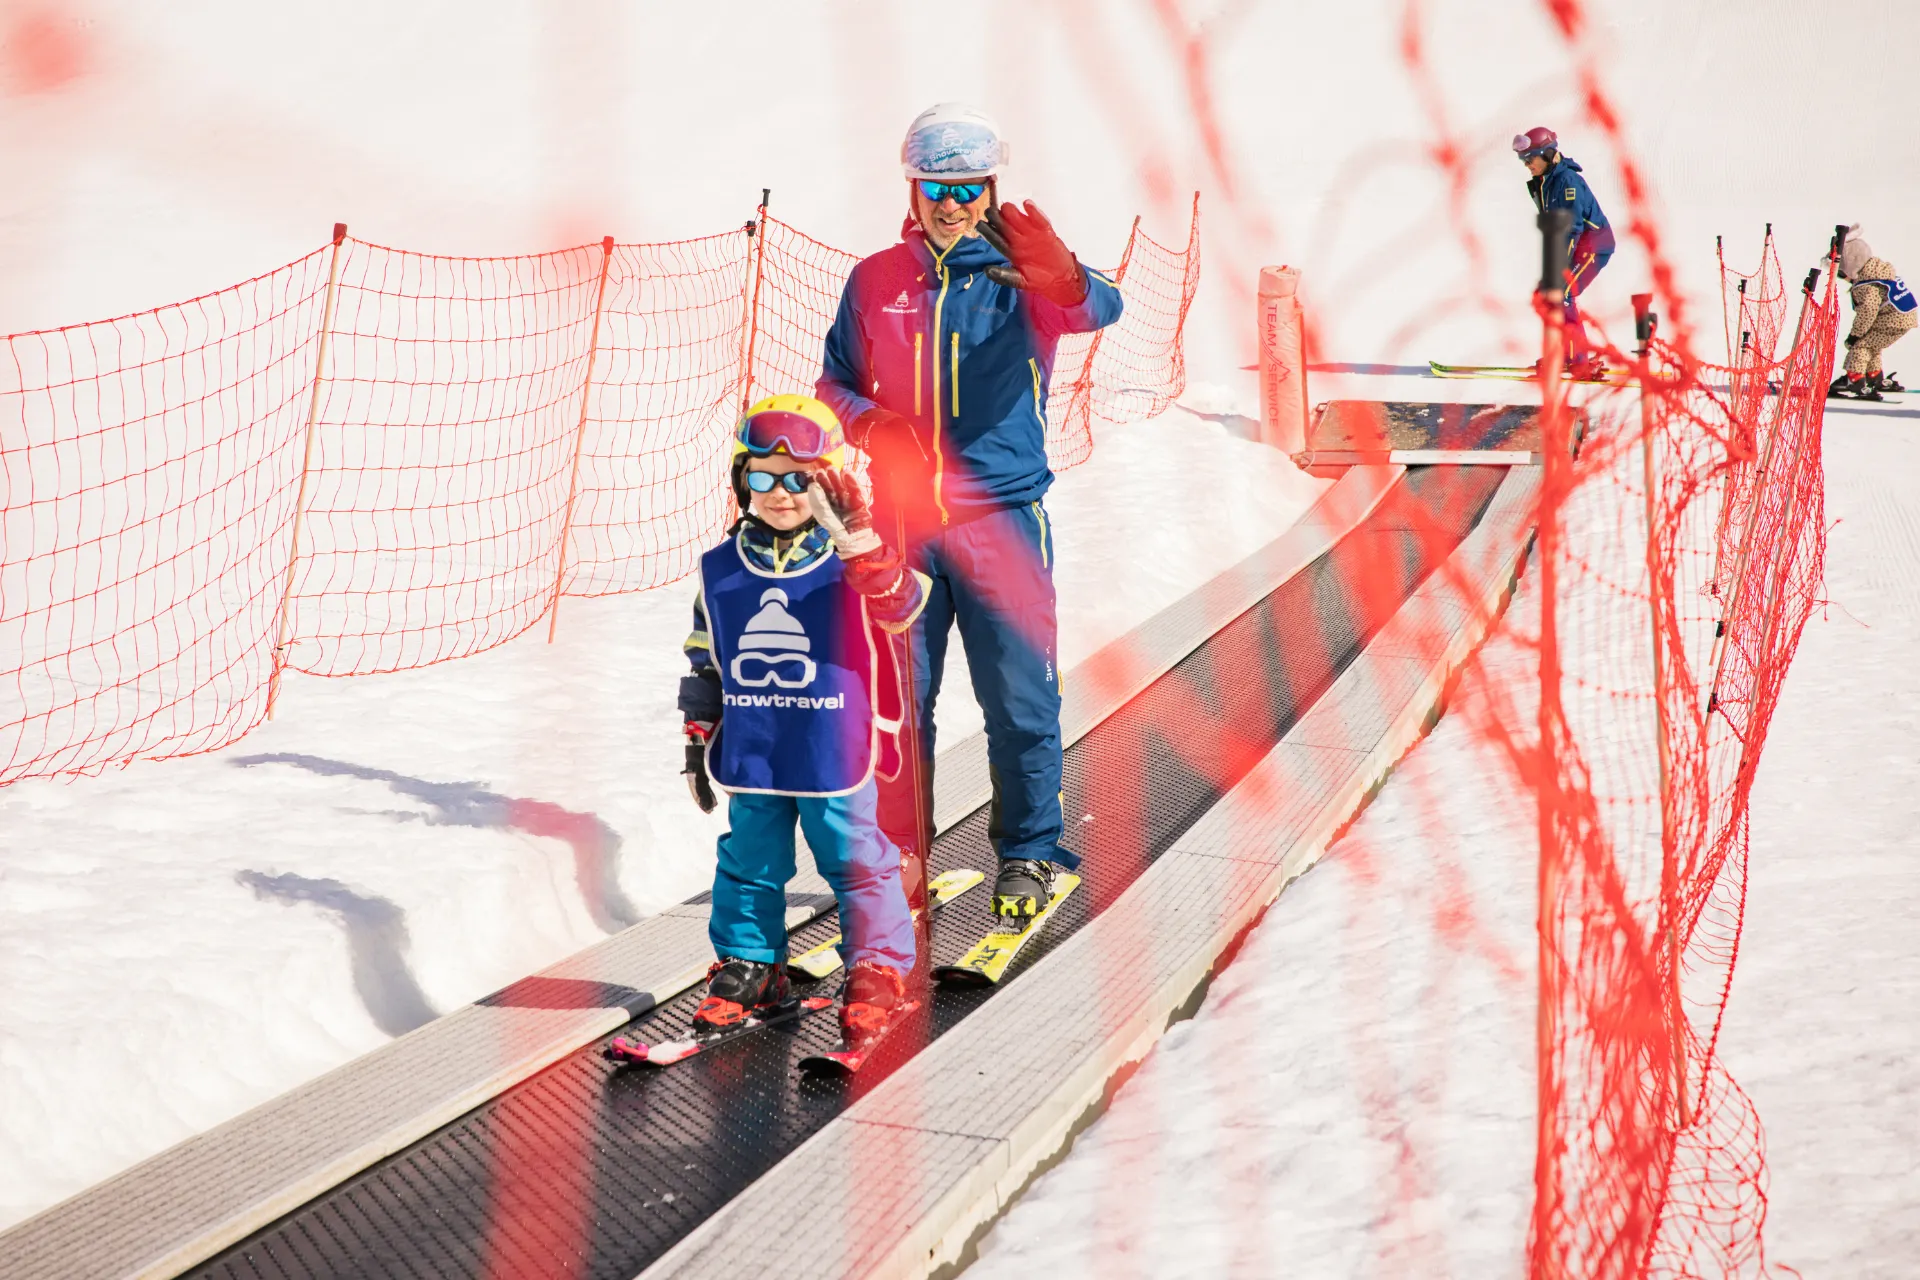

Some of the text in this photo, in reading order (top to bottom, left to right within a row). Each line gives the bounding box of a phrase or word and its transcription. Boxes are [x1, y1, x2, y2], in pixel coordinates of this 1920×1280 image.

[1267, 304, 1280, 428] TEAM SERVICE
[722, 688, 845, 710] nowtravel
